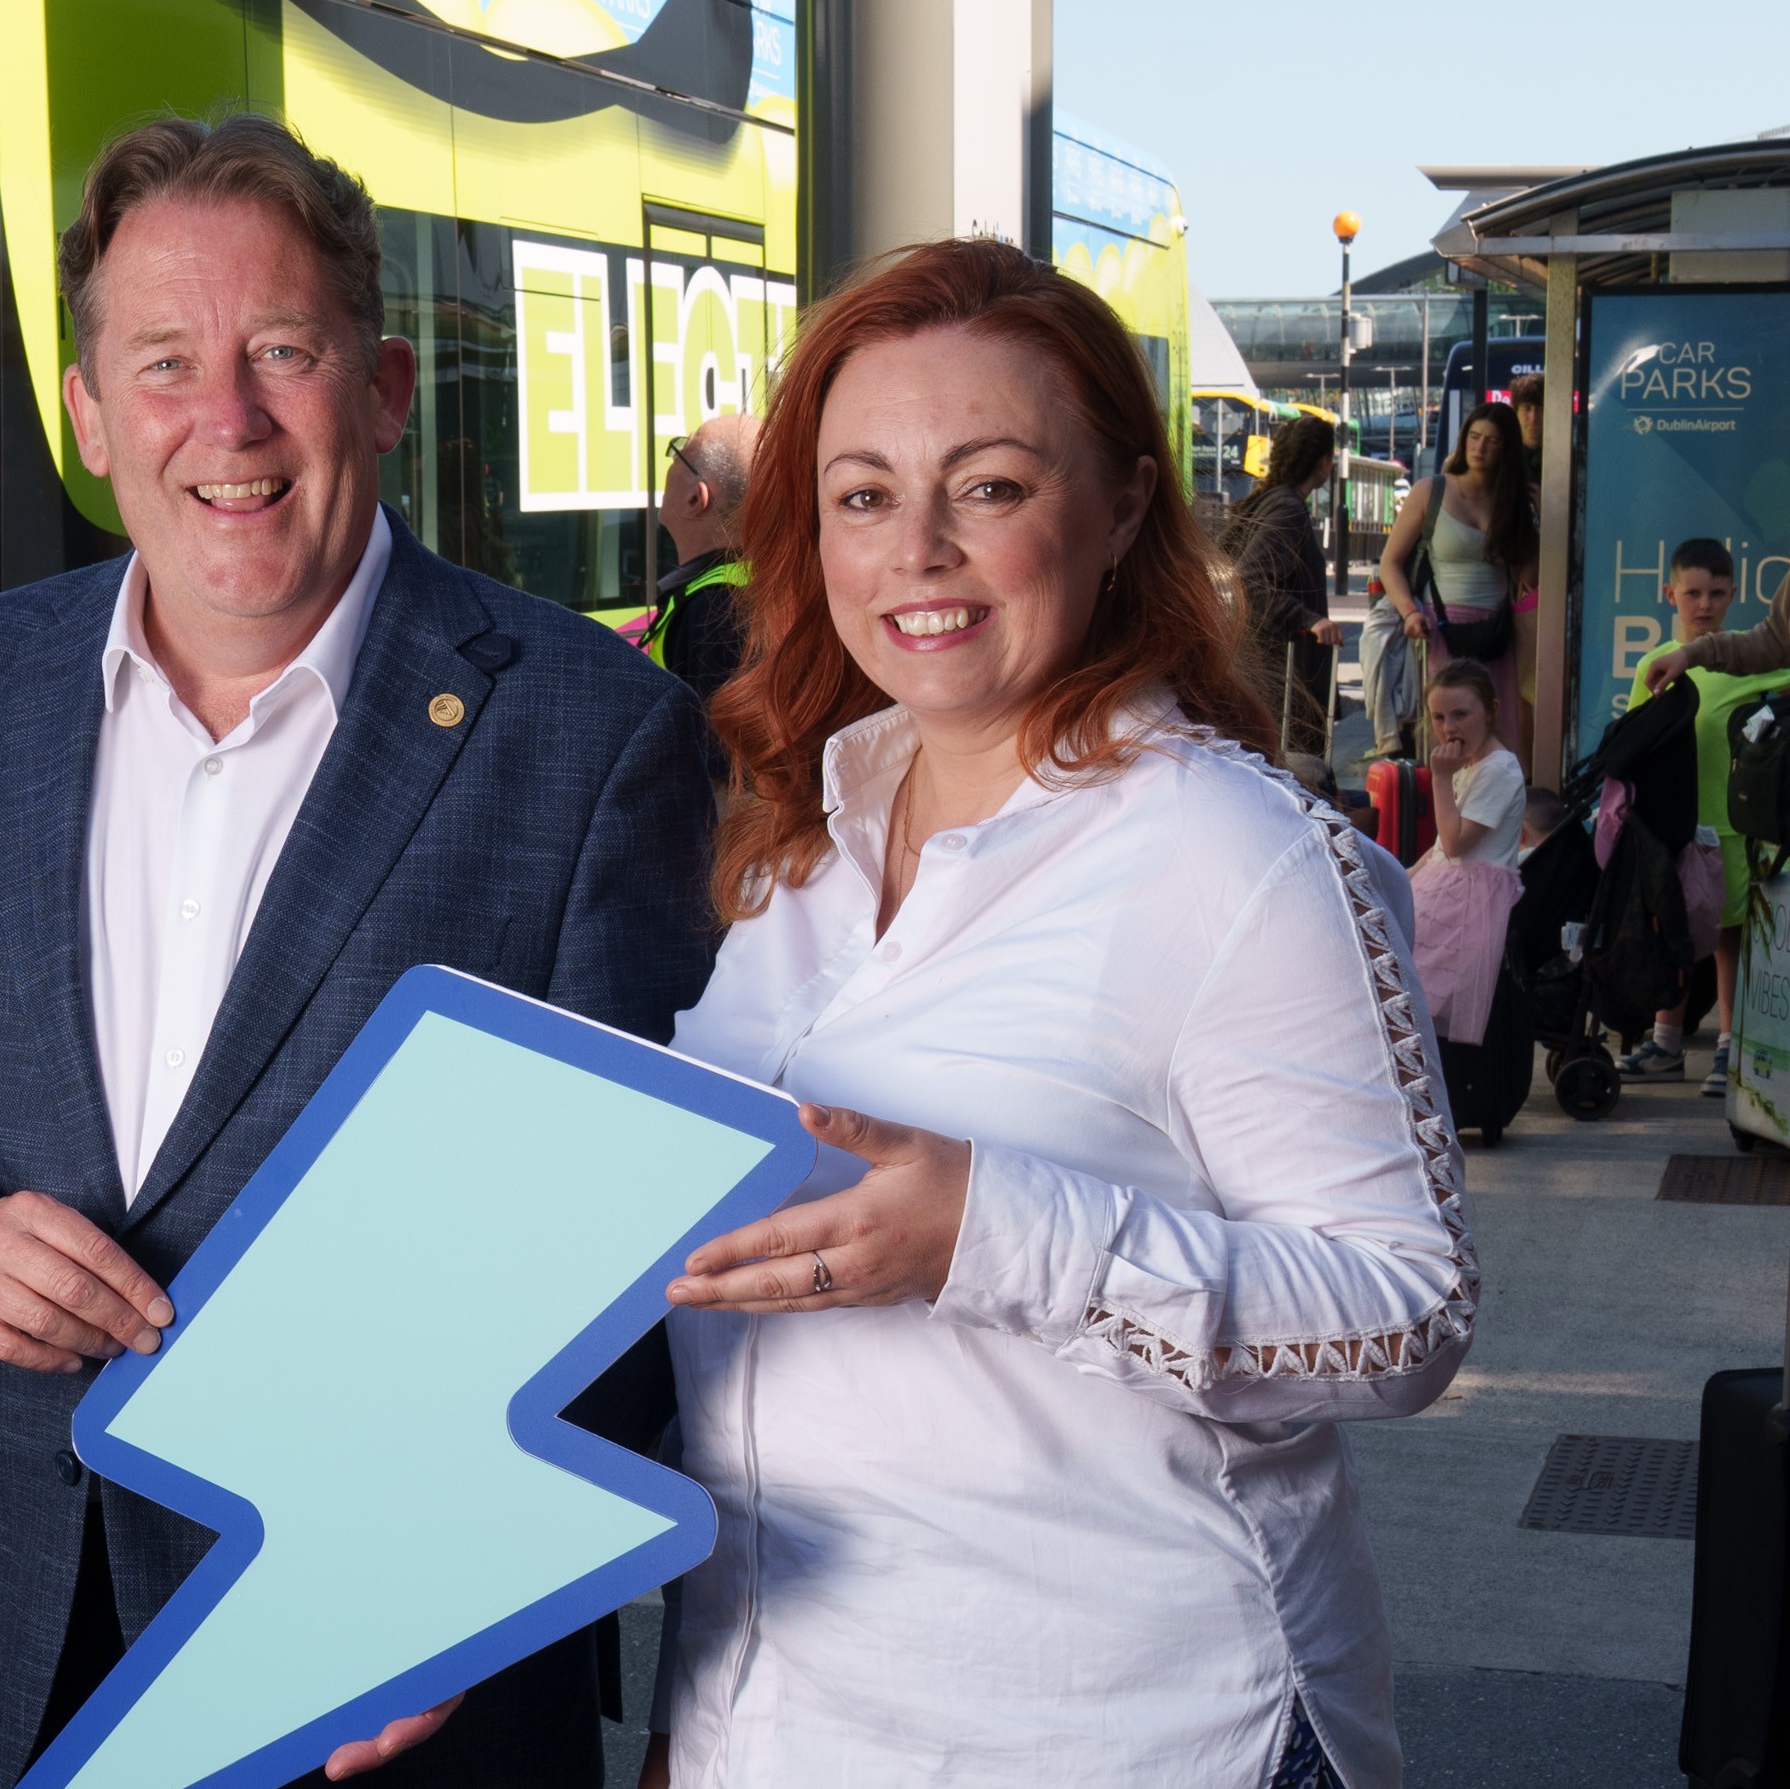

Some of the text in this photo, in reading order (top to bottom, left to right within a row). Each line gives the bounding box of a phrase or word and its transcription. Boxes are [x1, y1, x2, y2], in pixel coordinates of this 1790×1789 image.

[1659, 341, 1715, 365] CAR
[1620, 367, 1751, 399] PARKS
[1657, 419, 1736, 432] DublinAirport
[1222, 444, 1239, 459] 24
